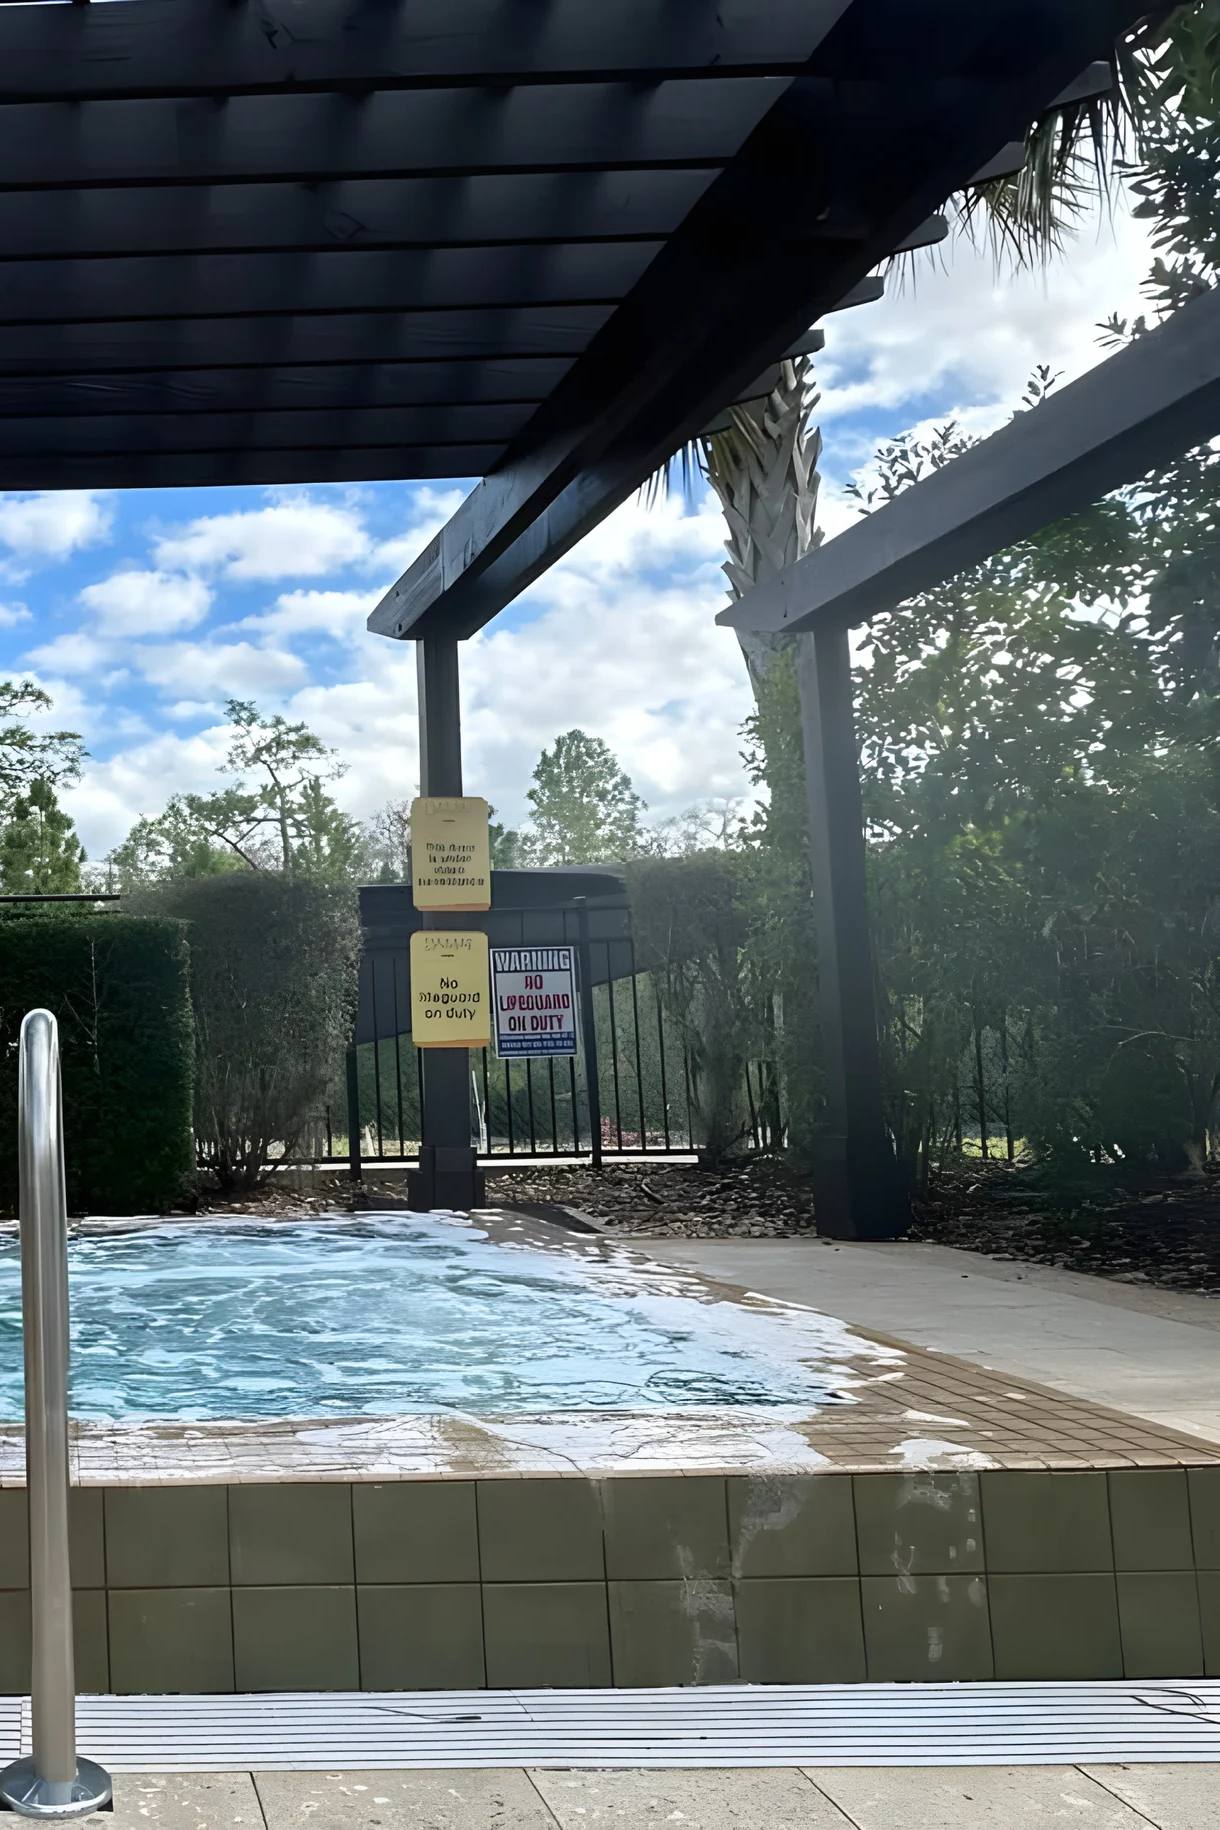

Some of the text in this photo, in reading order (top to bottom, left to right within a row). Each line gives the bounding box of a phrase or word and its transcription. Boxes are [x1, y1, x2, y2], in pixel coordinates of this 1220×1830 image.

[495, 950, 570, 972] WARNING
[425, 1009, 442, 1018] on
[530, 1014, 564, 1031] DUTY
